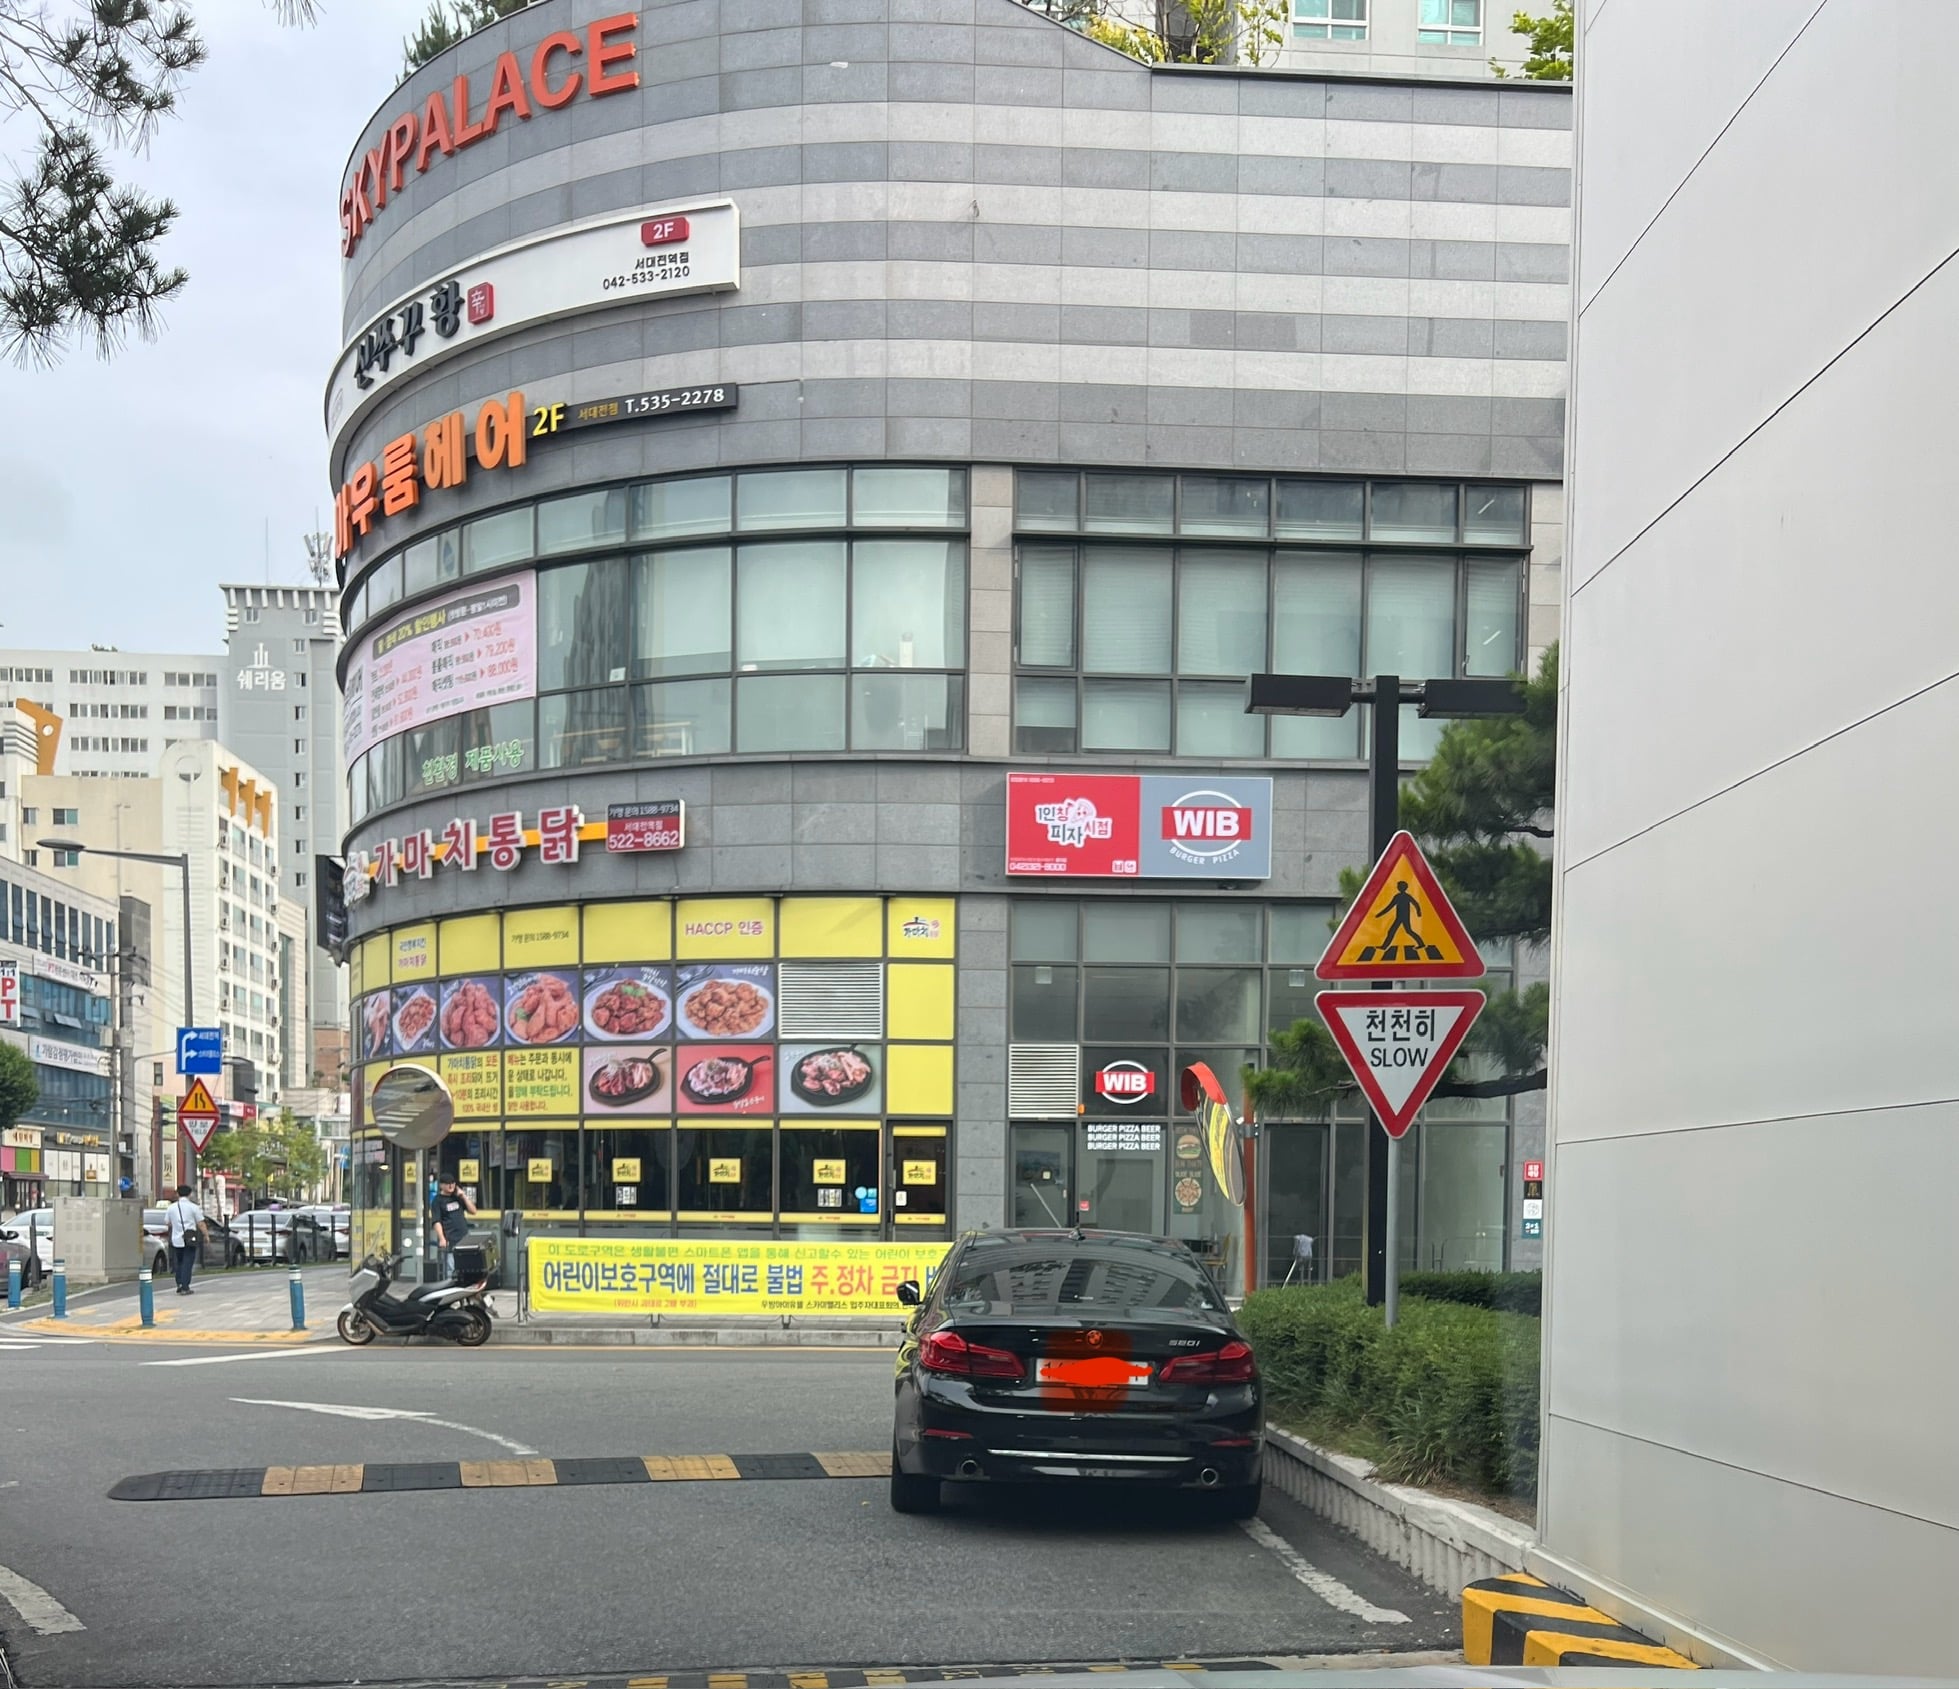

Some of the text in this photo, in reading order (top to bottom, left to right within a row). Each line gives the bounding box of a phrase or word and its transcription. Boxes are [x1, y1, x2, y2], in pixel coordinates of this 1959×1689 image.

[340, 12, 639, 258] SKYPALACE
[653, 221, 675, 240] 2F
[635, 251, 690, 270] 서대전역점
[602, 265, 690, 290] 042-533-2120
[625, 388, 725, 414] T.535-2278
[532, 402, 565, 437] 2F
[1038, 806, 1069, 822] 1인칭
[1173, 810, 1240, 837] WIB
[608, 830, 679, 849] 522-8662
[1051, 820, 1109, 844] 피자 시점
[374, 805, 584, 887] 가마치통닭
[1169, 846, 1240, 865] BURGER PIZZA
[685, 920, 764, 937] HACCP 인증
[1366, 1009, 1435, 1042] 천천히
[528, 1053, 549, 1065] 주문과
[550, 1051, 572, 1064] 동시에
[1370, 1047, 1429, 1068] SLOW
[1103, 1074, 1147, 1091] WIB
[1087, 1125, 1161, 1133] BURGER PIZZA BEER
[1087, 1133, 1161, 1141] BURGER PIZZA BEER
[1087, 1142, 1161, 1150] BURGER PIZZA BEER
[549, 1244, 560, 1255] 이
[565, 1244, 625, 1257] 도로구역은
[631, 1245, 679, 1258] 생활불편
[684, 1246, 731, 1259] 스마트폰
[766, 1247, 789, 1260] 통해
[847, 1247, 869, 1260] 있는
[875, 1248, 910, 1260] 어린이
[544, 1261, 694, 1294] 어린이보호구역에
[702, 1263, 759, 1294] 절대로
[766, 1264, 803, 1295] 불법
[810, 1265, 874, 1296] 주.정차
